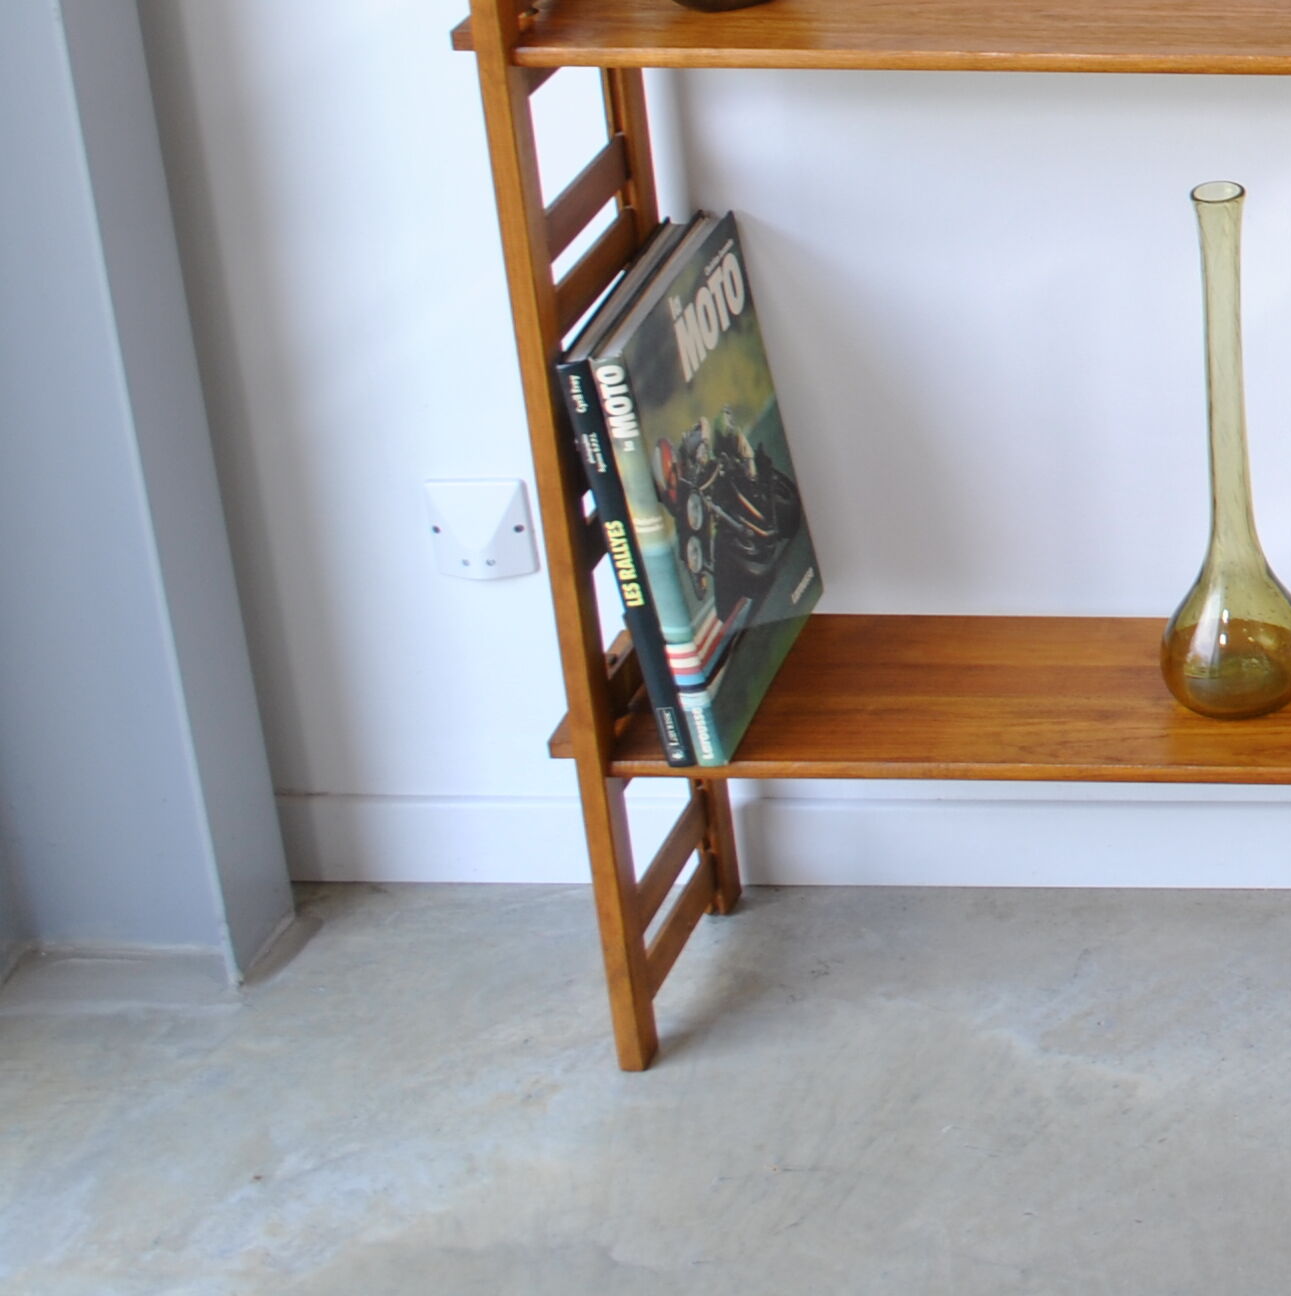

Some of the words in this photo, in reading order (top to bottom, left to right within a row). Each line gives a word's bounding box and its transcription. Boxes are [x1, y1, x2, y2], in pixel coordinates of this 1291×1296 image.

[674, 253, 745, 383] MOTO
[596, 365, 639, 439] MOTO
[605, 520, 637, 581] RALLYES
[622, 582, 645, 607] LES
